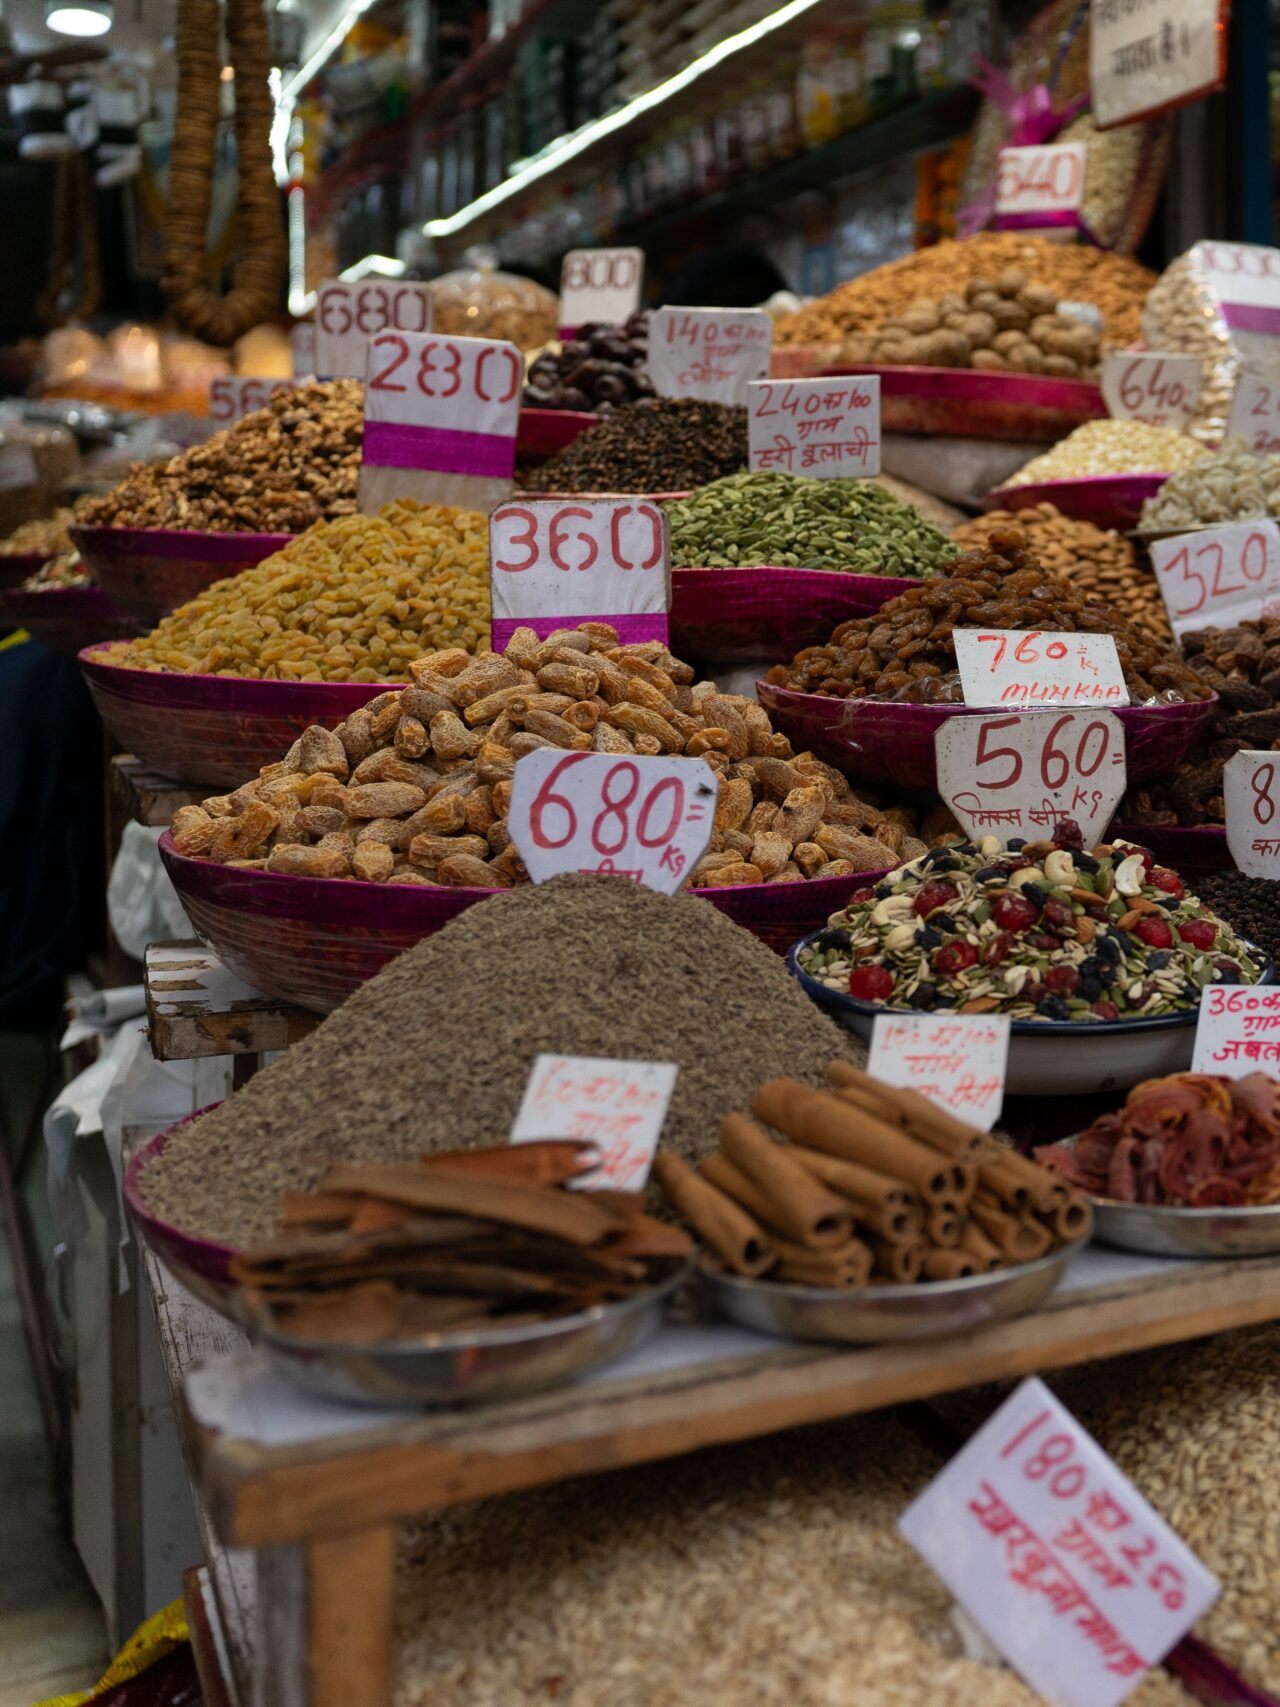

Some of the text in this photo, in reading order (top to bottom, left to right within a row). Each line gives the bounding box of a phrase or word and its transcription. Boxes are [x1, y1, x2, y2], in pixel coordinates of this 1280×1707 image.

[565, 254, 638, 292] 800
[320, 287, 427, 335] 680
[666, 316, 719, 344] 140
[369, 335, 521, 403] 280
[755, 383, 822, 418] 240
[495, 505, 662, 572] 360
[1208, 988, 1260, 1016] 360
[1000, 1409, 1086, 1499] 180
[1120, 1535, 1187, 1611] 250
